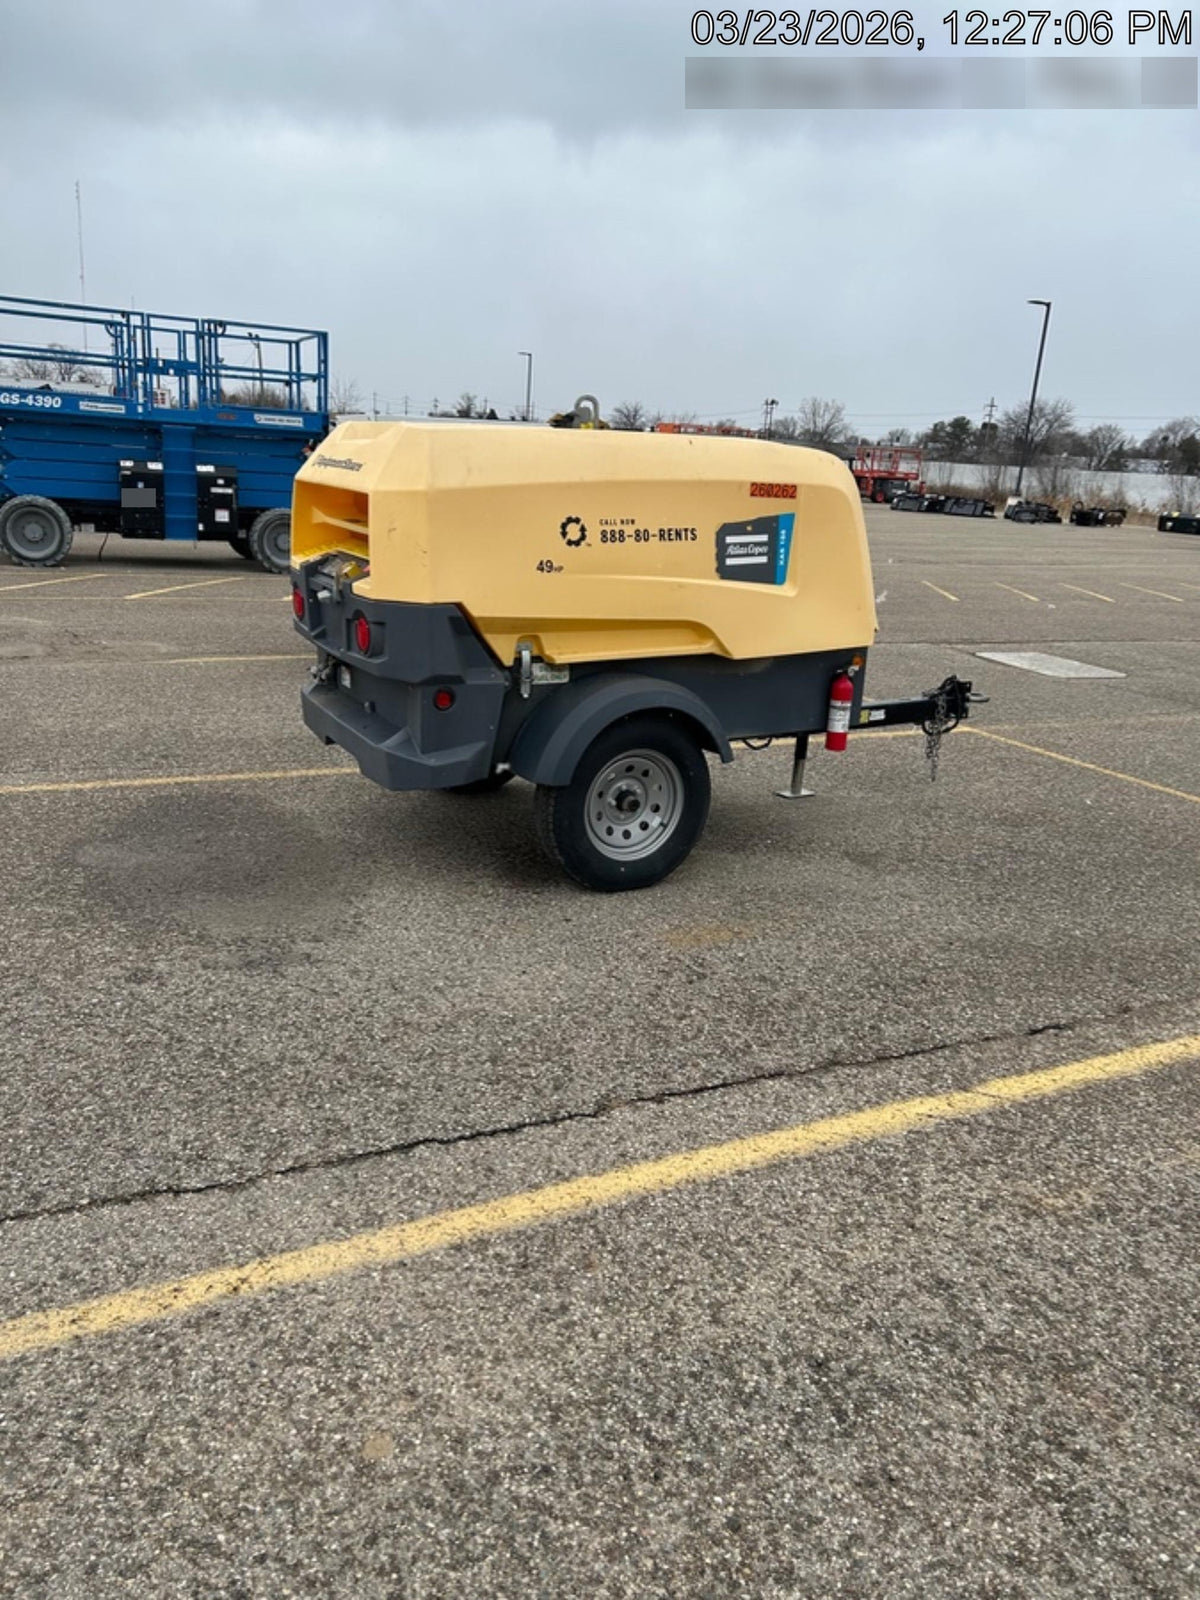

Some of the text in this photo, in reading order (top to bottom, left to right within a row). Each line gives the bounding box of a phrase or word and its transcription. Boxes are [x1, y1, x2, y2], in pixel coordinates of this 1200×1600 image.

[0, 392, 62, 408] GS-4390
[750, 482, 797, 499] 260262
[600, 527, 698, 544] 888-80-RENTS
